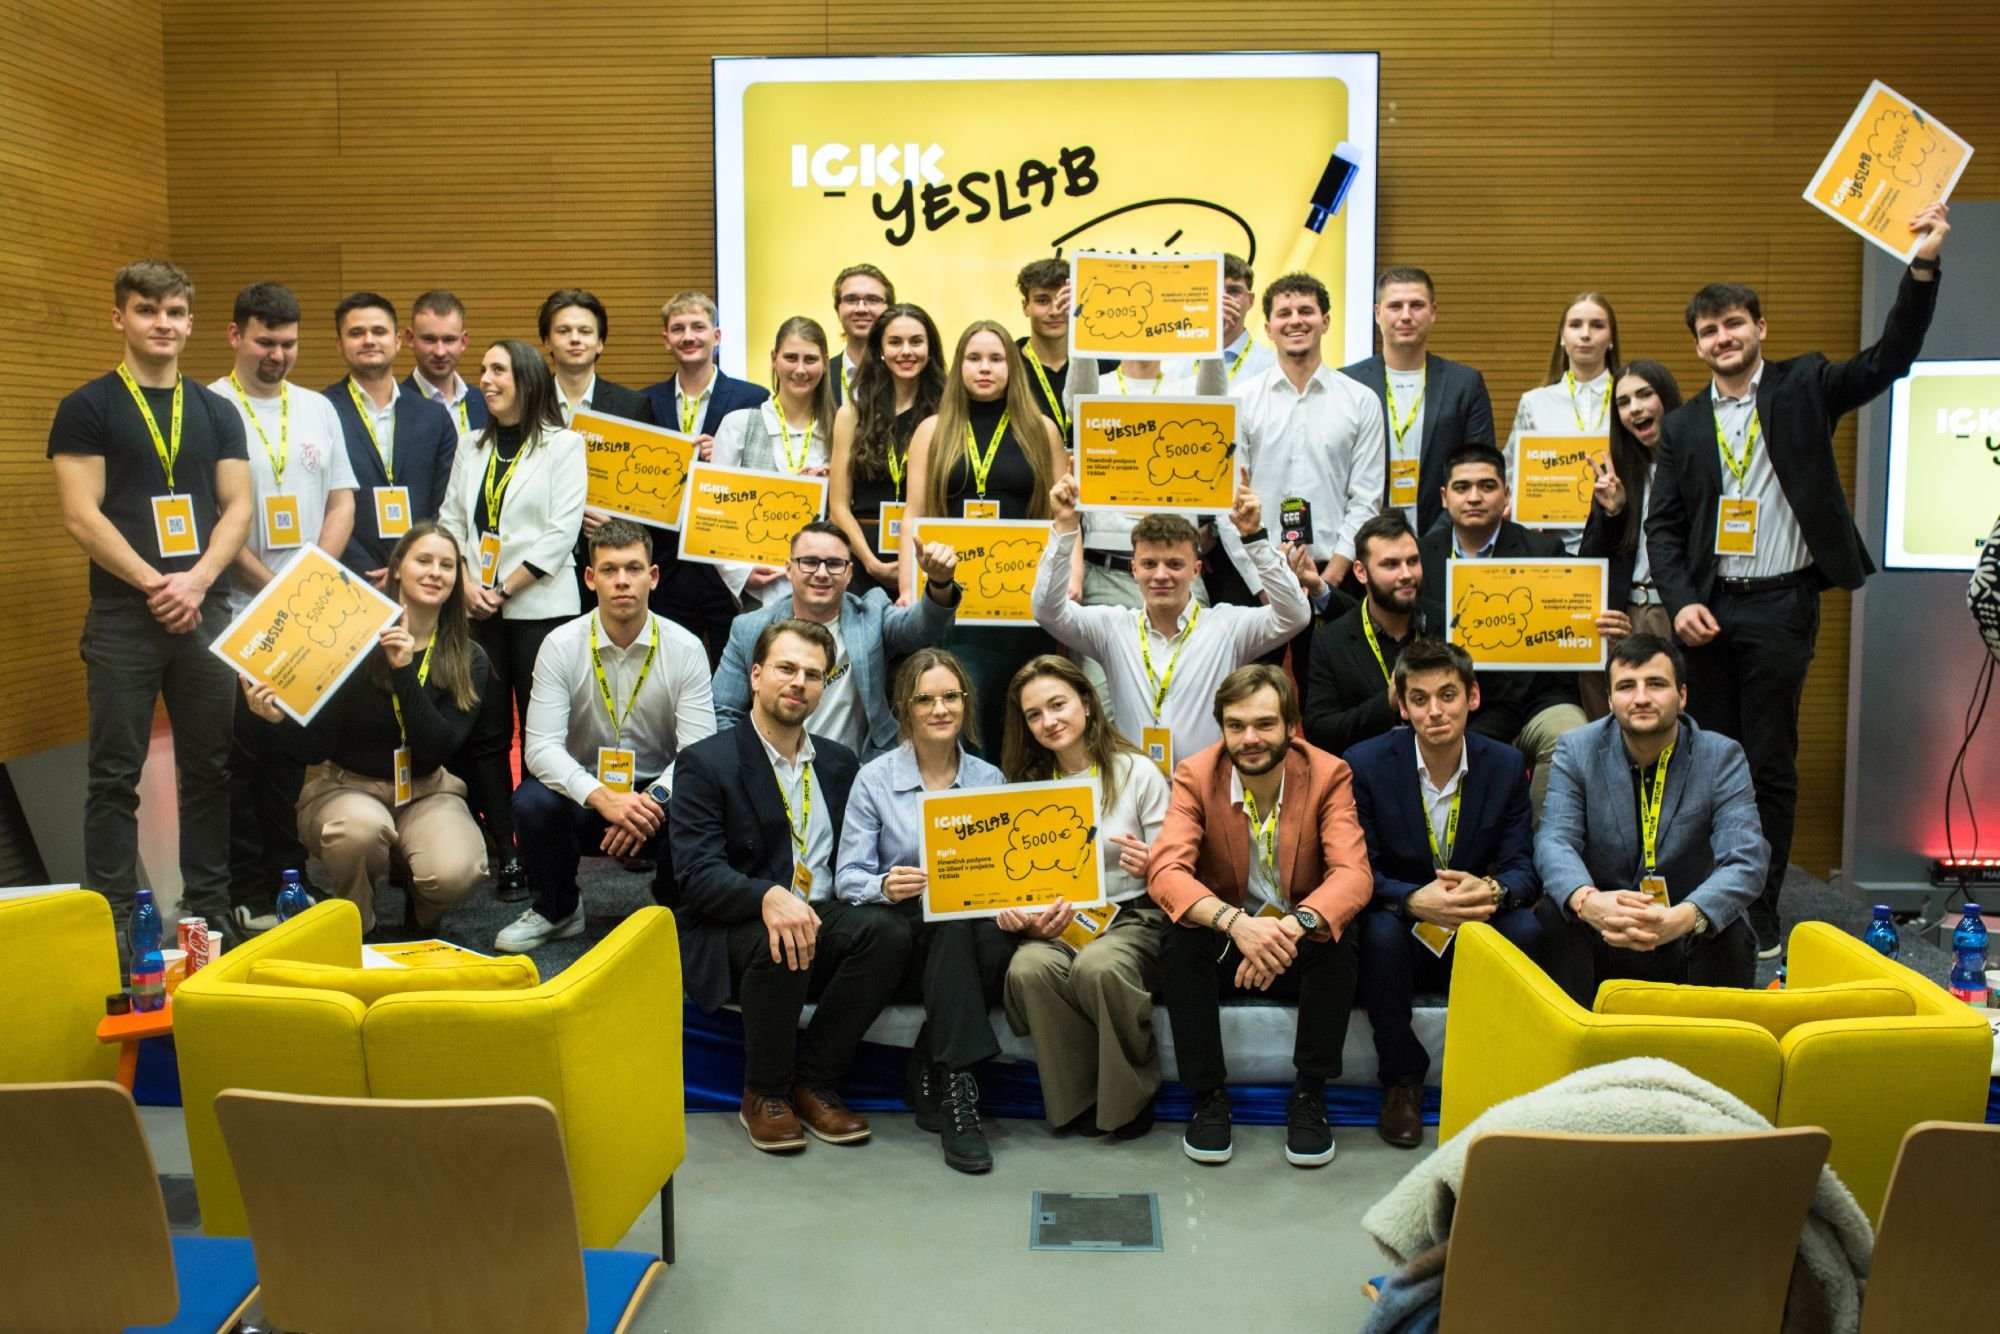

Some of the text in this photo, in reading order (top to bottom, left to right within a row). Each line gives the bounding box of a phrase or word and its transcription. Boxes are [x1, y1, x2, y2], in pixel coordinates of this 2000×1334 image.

[1848, 152, 1873, 199] YESLAB
[872, 146, 1099, 247] YESLAB
[1145, 318, 1193, 337] YESLAB
[1104, 420, 1157, 442] YESLAB
[588, 440, 631, 453] YESLAB
[1542, 451, 1587, 469] YESLAB
[713, 490, 757, 504] YESLAB
[956, 547, 985, 562] SLAB
[258, 610, 289, 653] YESLAB
[1525, 625, 1575, 647] YESLAB
[954, 812, 1010, 841] YESLAB
